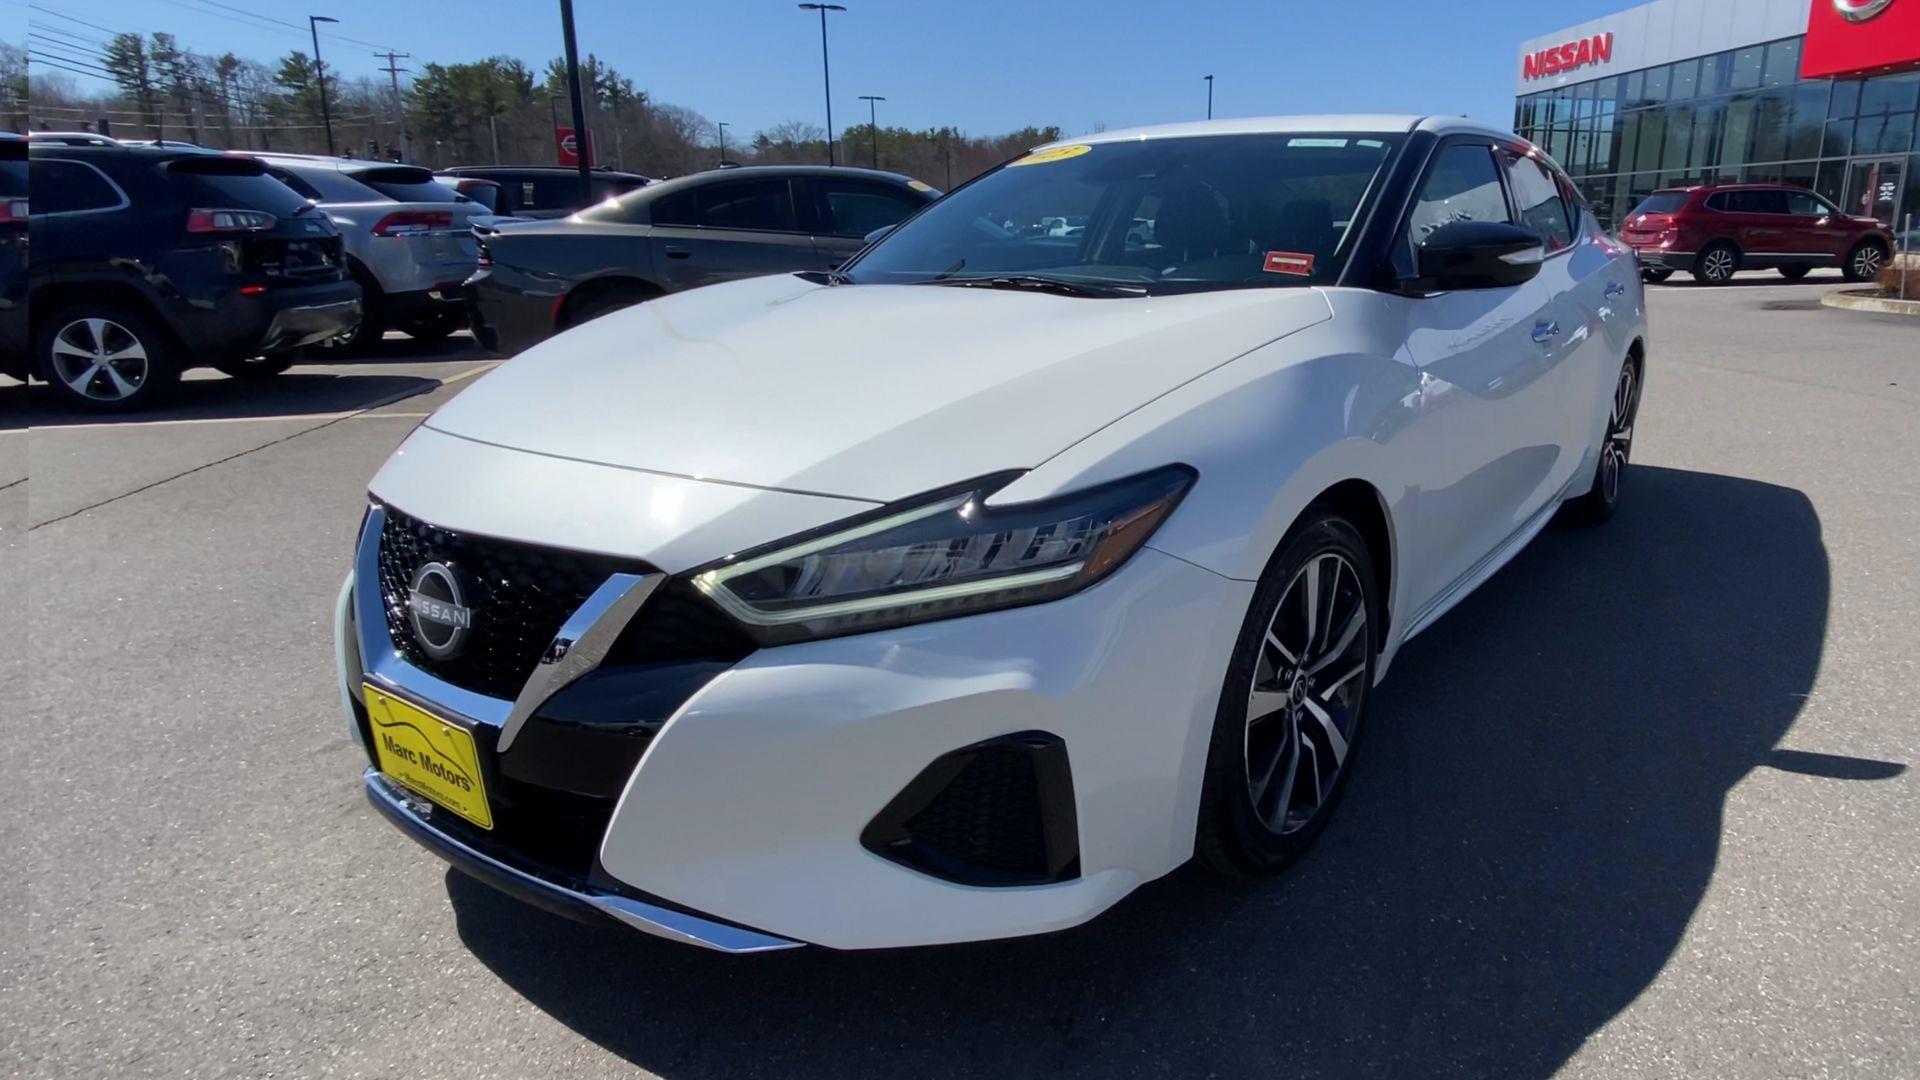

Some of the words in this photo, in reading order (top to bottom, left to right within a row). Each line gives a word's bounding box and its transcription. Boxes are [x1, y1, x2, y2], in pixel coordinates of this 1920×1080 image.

[1524, 32, 1612, 80] NISSAN
[410, 593, 466, 625] NISSAN
[382, 733, 417, 765] Marc
[419, 751, 471, 792] Motors
